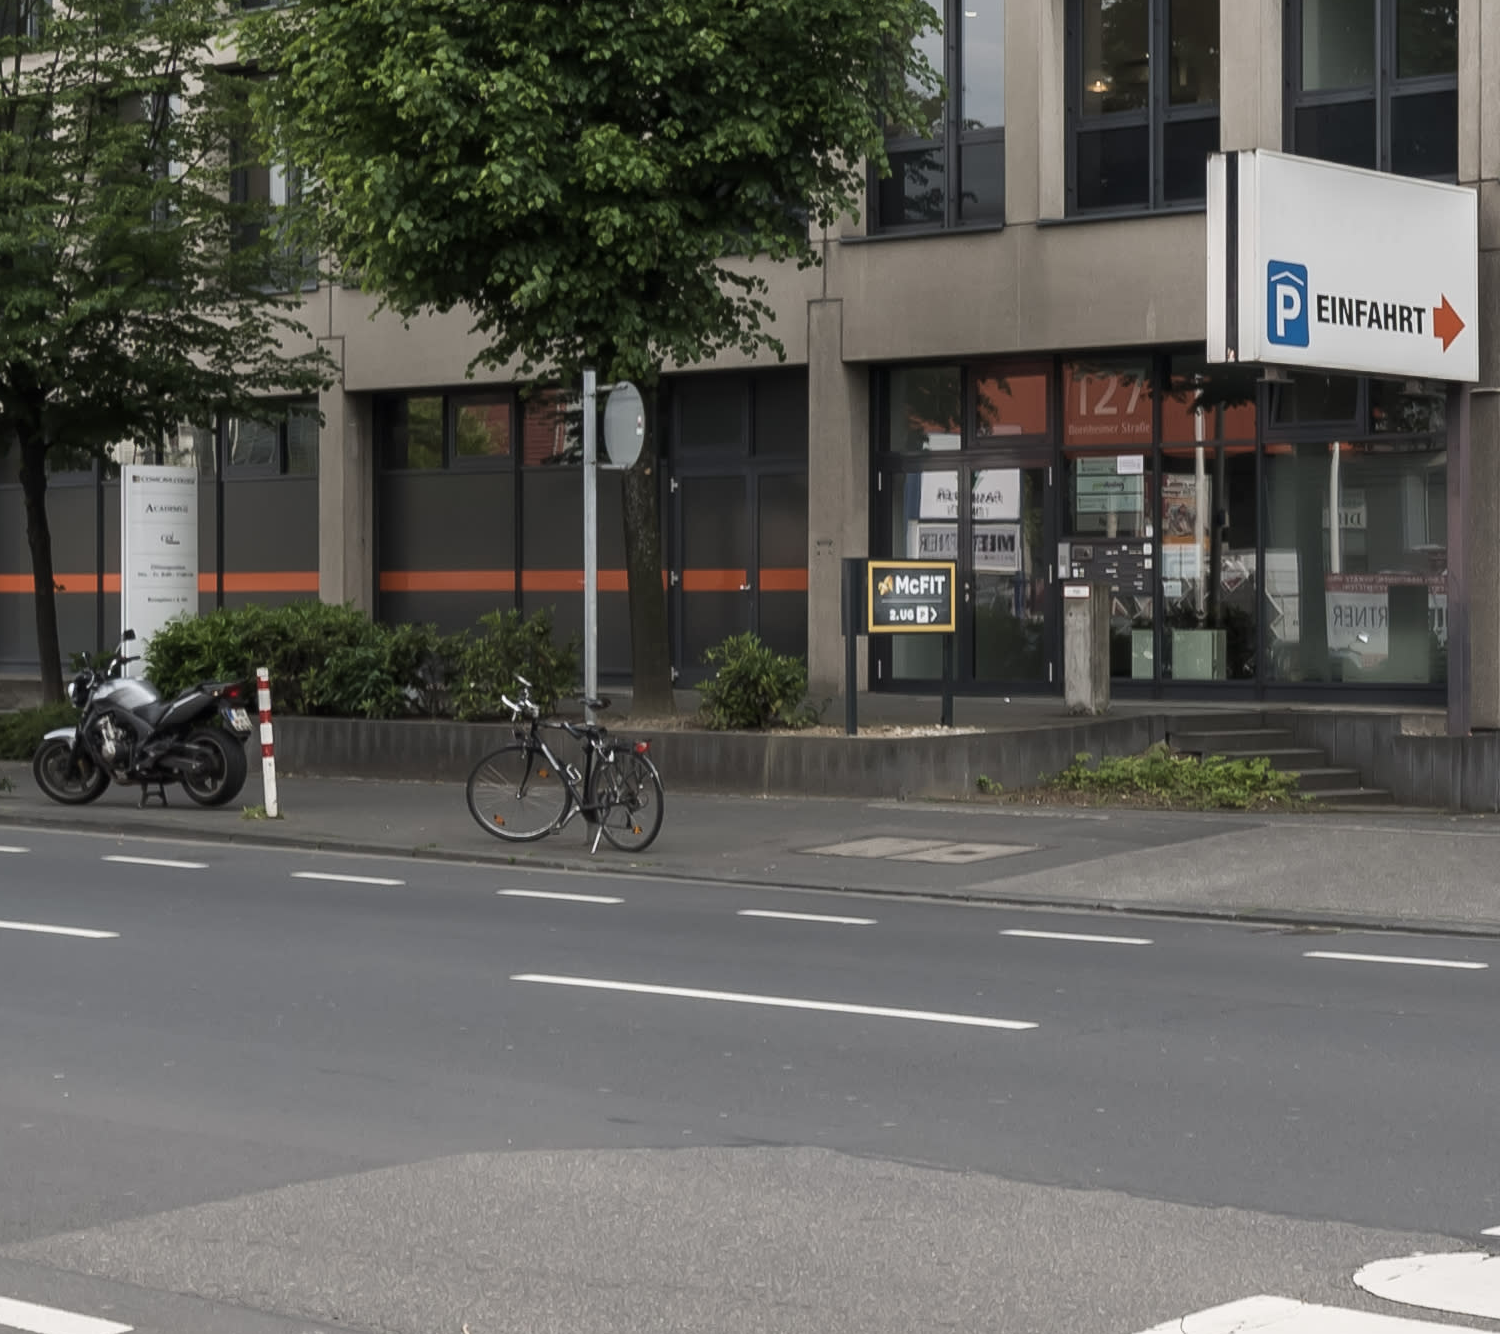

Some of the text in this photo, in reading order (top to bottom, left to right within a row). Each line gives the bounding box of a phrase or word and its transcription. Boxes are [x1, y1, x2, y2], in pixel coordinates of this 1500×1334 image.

[1316, 293, 1426, 335] EINFAHRT
[1121, 420, 1150, 434] Straße
[895, 574, 946, 595] McFIT
